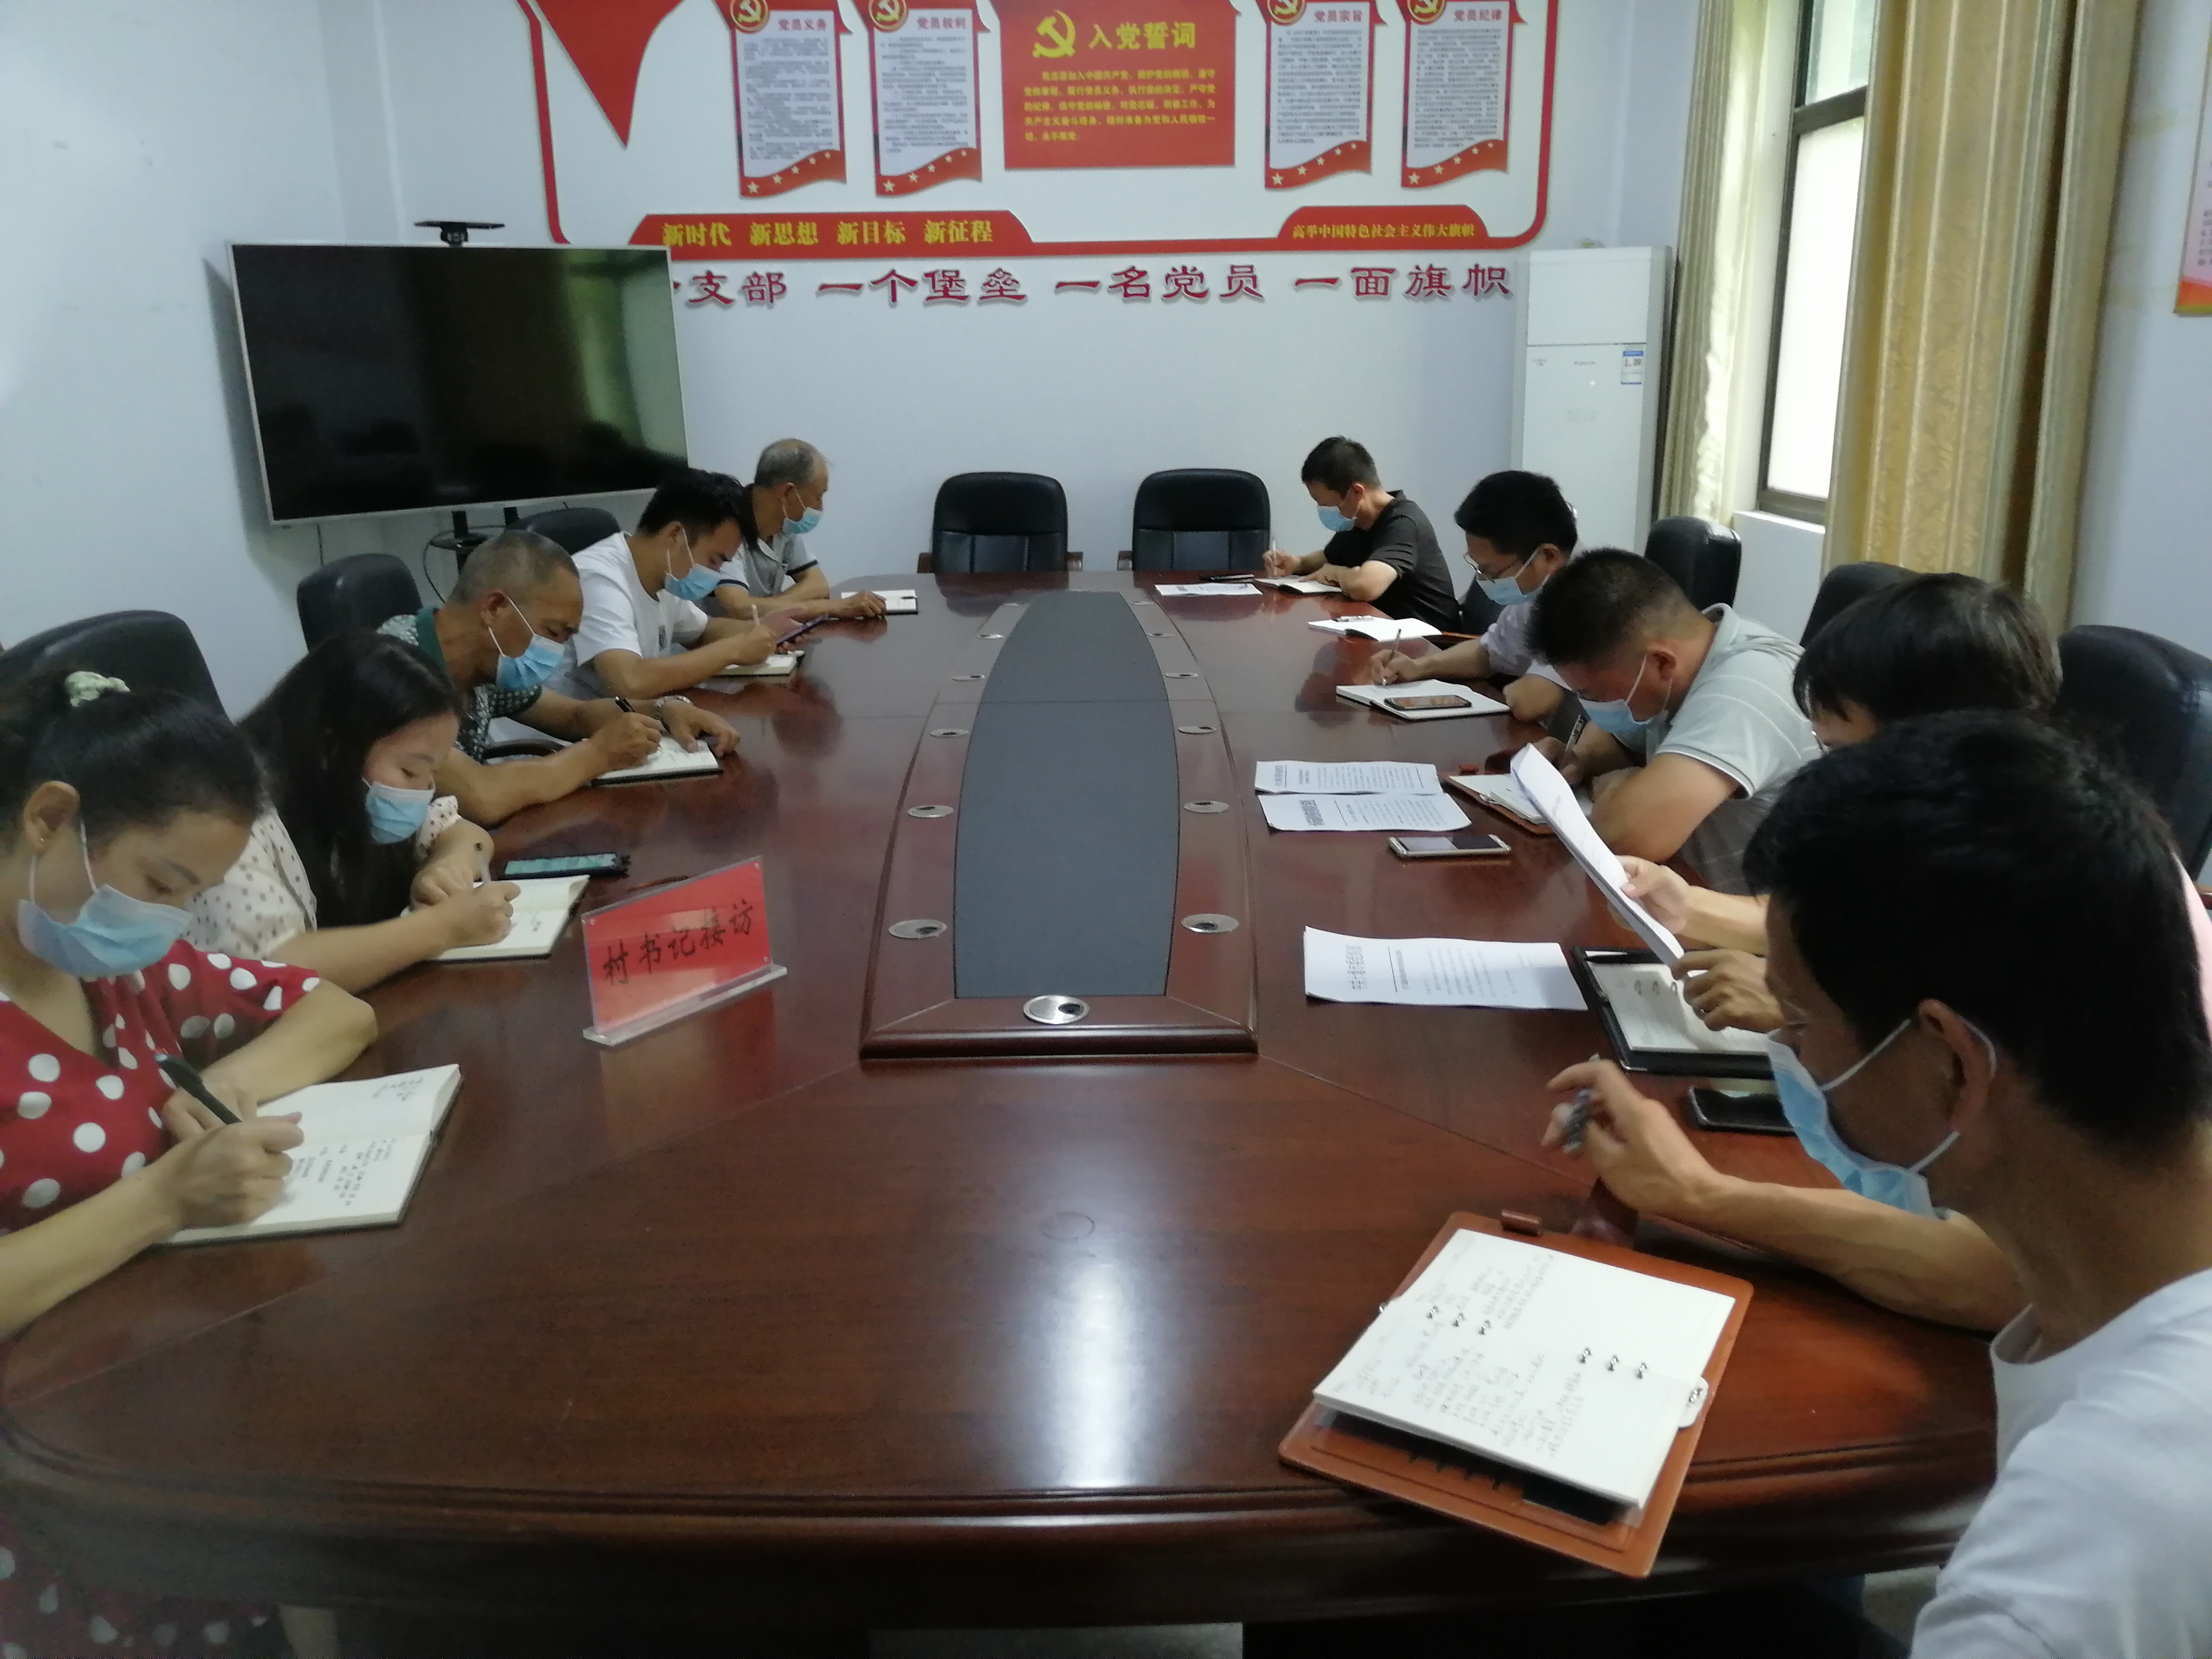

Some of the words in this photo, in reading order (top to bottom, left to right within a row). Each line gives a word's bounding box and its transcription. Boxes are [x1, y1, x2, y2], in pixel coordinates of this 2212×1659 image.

[778, 19, 827, 32] 党员义务
[917, 17, 966, 30] 党员权利
[1088, 22, 1195, 49] 入党誓词
[663, 222, 731, 247] 新时代
[750, 221, 818, 246] 新思想
[837, 220, 906, 245] 新目标
[924, 219, 993, 243] 新征程
[1293, 223, 1475, 238] 高举中国特色社会主义伟大旗帜
[673, 271, 786, 305] 支部
[819, 268, 1027, 304] 一个堡垒
[1055, 265, 1264, 300] 一名党员
[1294, 263, 1513, 297] 一面旗帜
[603, 899, 753, 985] 村书记接访
